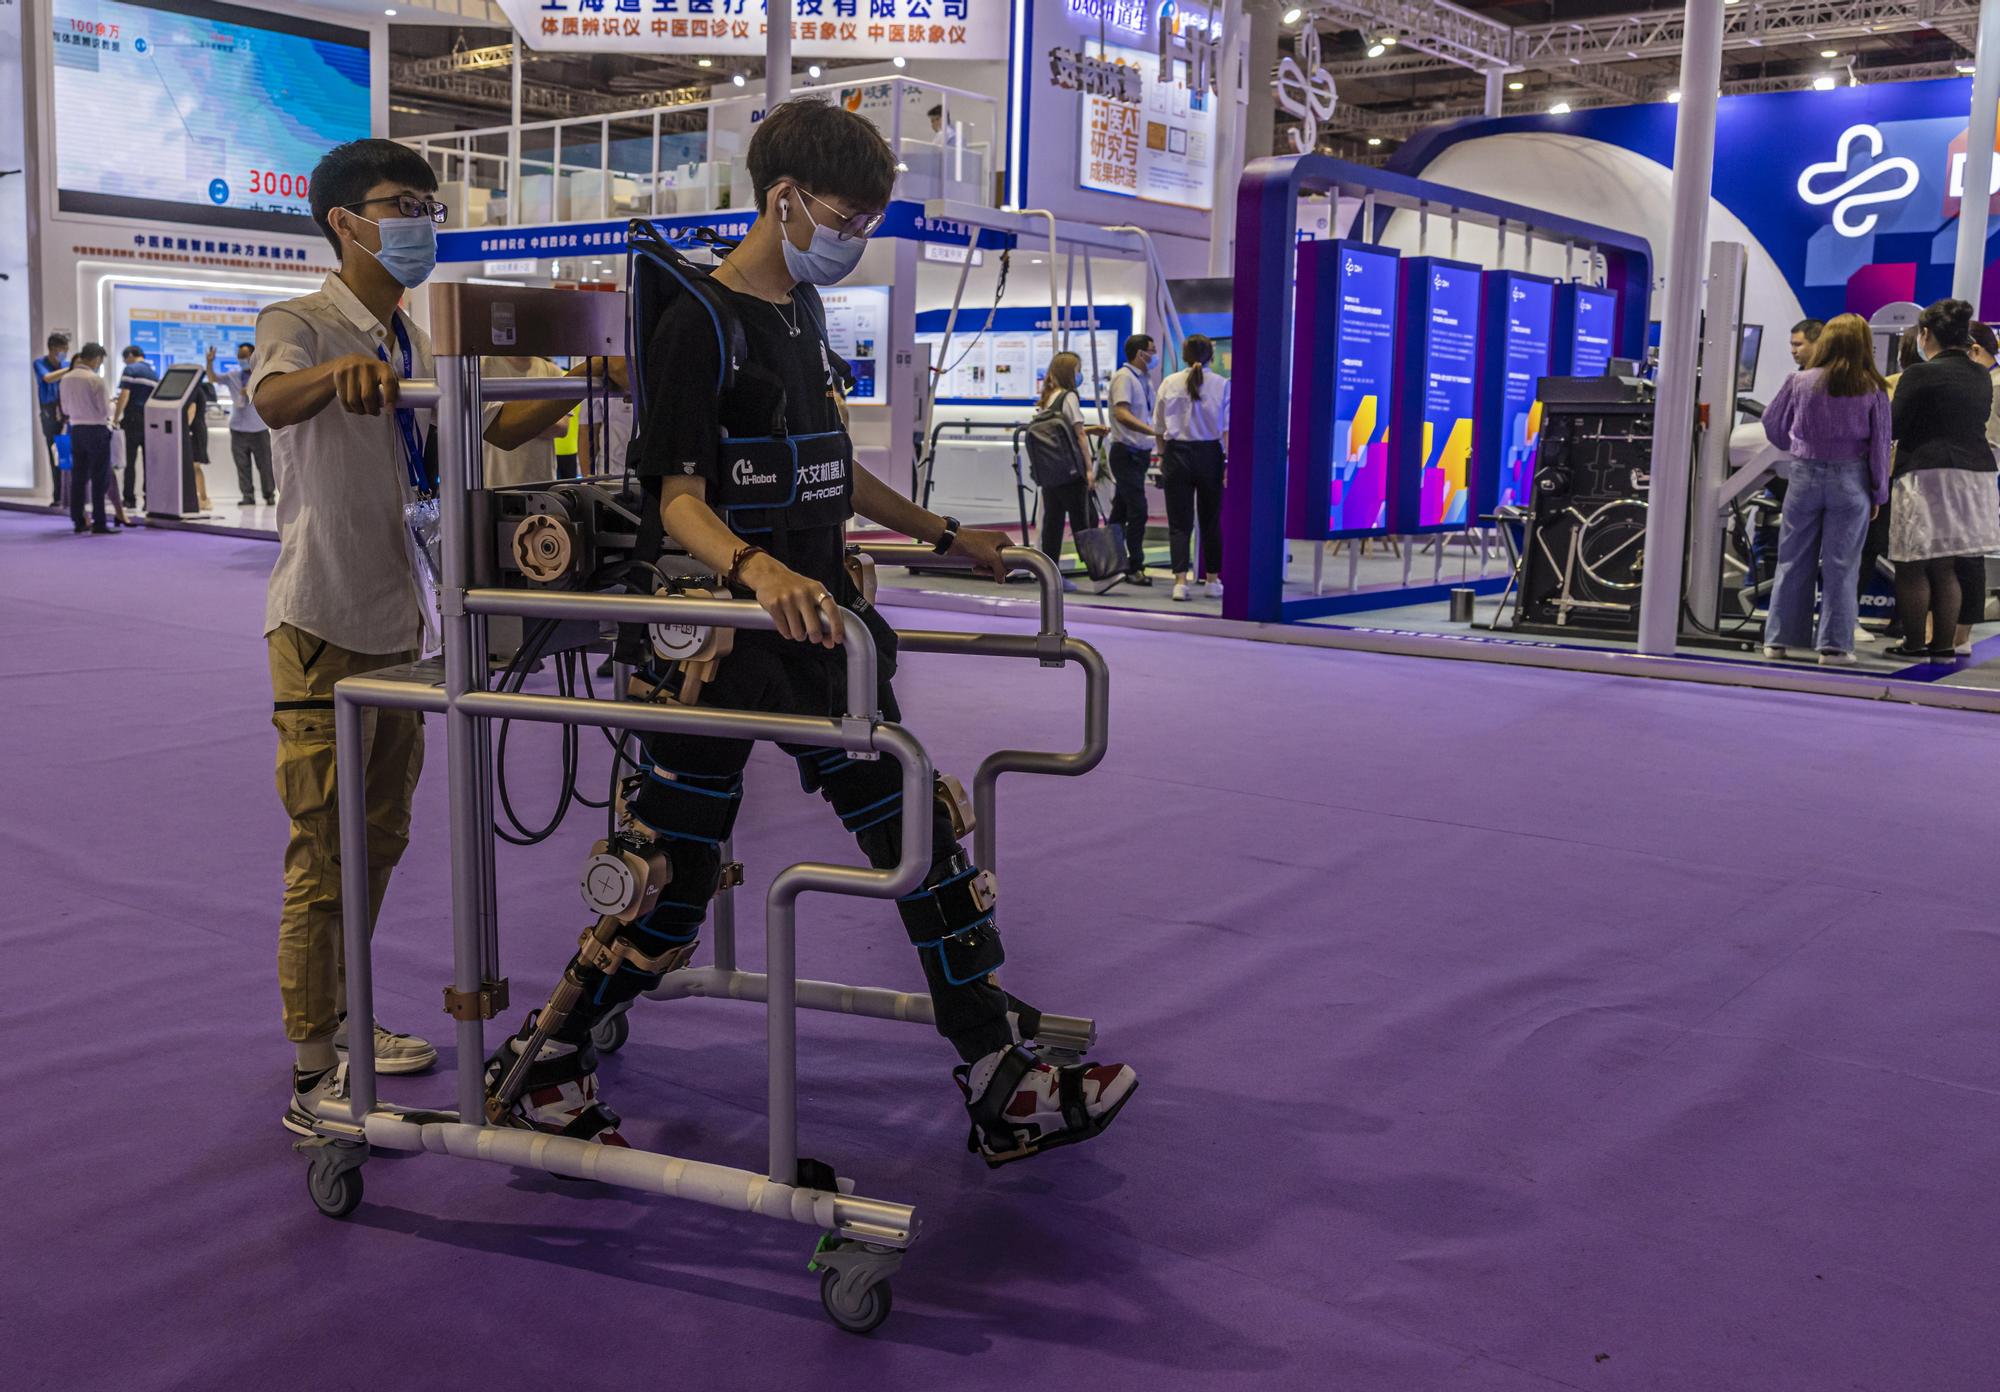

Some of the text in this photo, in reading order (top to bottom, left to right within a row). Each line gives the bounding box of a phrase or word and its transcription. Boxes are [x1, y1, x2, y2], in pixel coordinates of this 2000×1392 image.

[541, 16, 641, 36] 体质辨识仪
[651, 18, 750, 38] 中医四诊仪
[868, 23, 967, 44] 中医脉象仪
[248, 169, 308, 199] 3000
[796, 459, 846, 485] 大艾机器人
